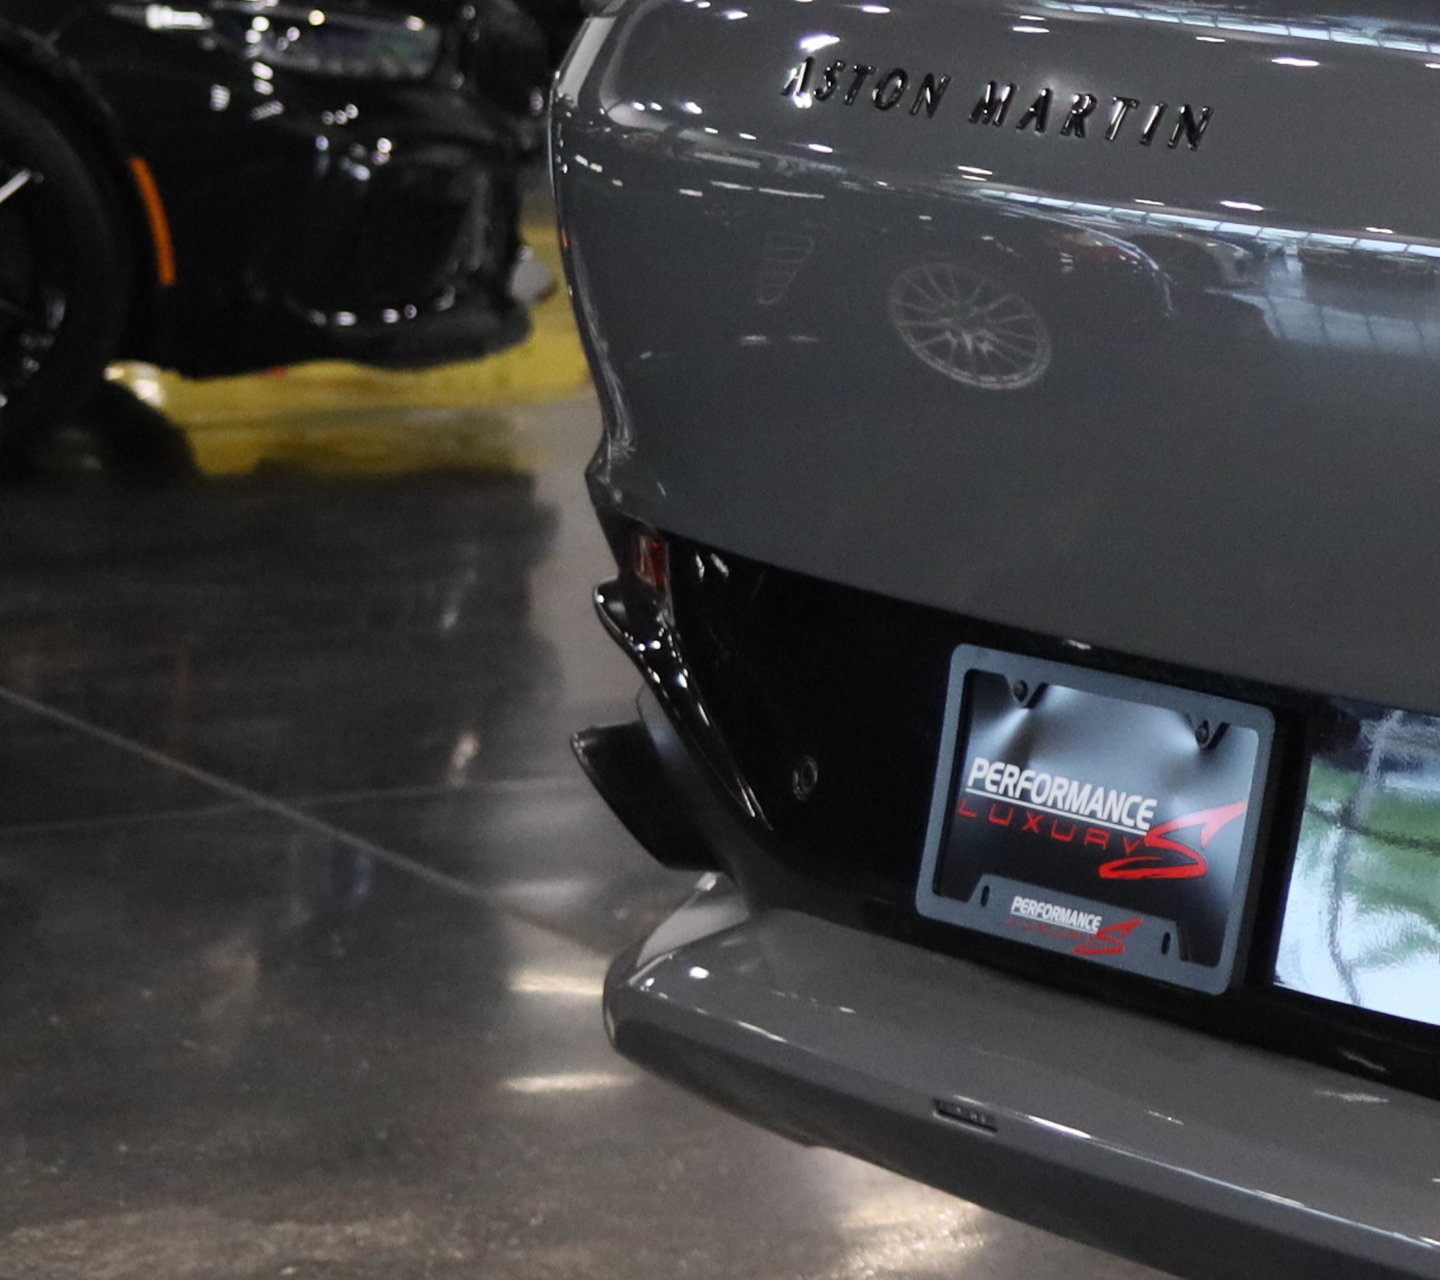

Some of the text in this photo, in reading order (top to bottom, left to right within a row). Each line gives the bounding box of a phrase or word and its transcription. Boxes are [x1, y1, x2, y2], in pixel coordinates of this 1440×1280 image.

[780, 55, 1214, 151] ASTON MARTIN
[955, 796, 1149, 855] LUXURY
[966, 756, 1158, 830] PERFORMANCE
[1010, 895, 1103, 932] PERFORMANCE
